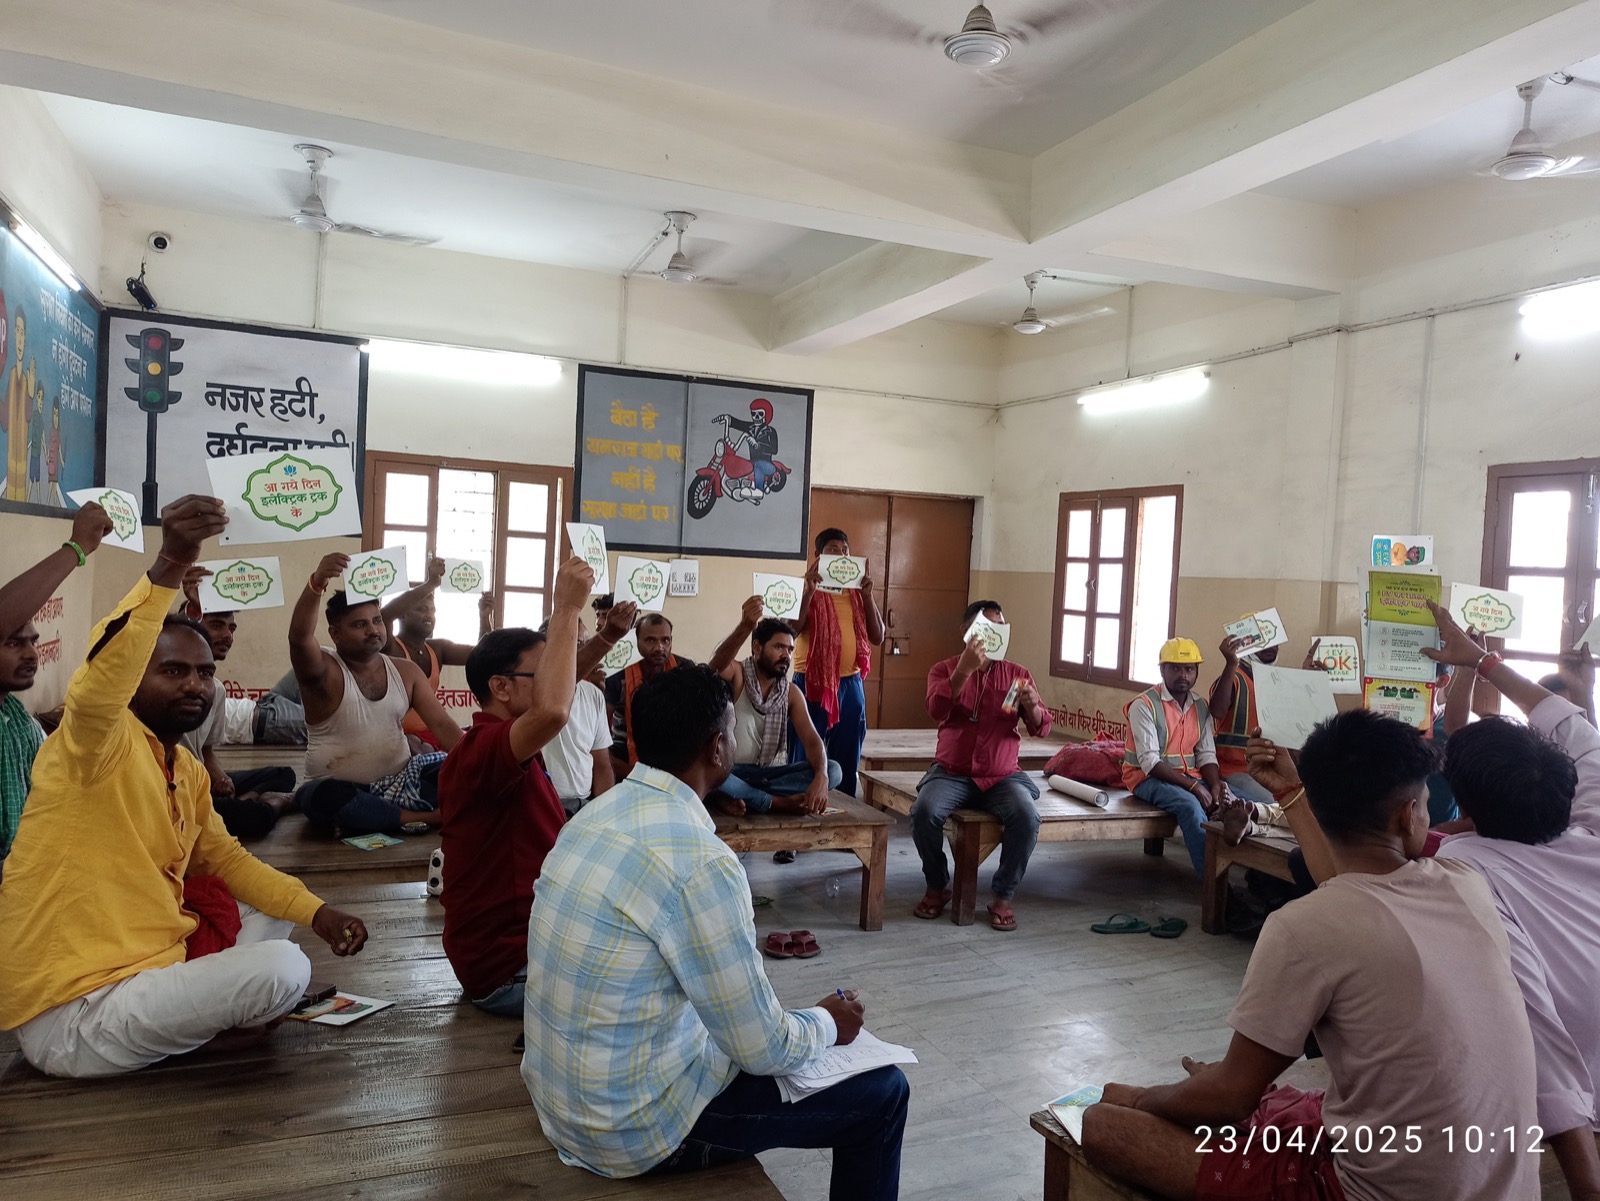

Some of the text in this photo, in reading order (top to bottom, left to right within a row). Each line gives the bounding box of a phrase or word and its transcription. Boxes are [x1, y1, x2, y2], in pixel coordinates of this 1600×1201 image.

[205, 376, 325, 424] नजर हटी,
[610, 400, 660, 432] बैठा है
[264, 478, 321, 493] आ गये दिन
[610, 465, 657, 496] नहीं है
[260, 491, 328, 507] इलेक्ट्रिक ट्रक
[290, 507, 302, 518] के
[1322, 656, 1352, 670] OK
[1078, 708, 1092, 734] फिर
